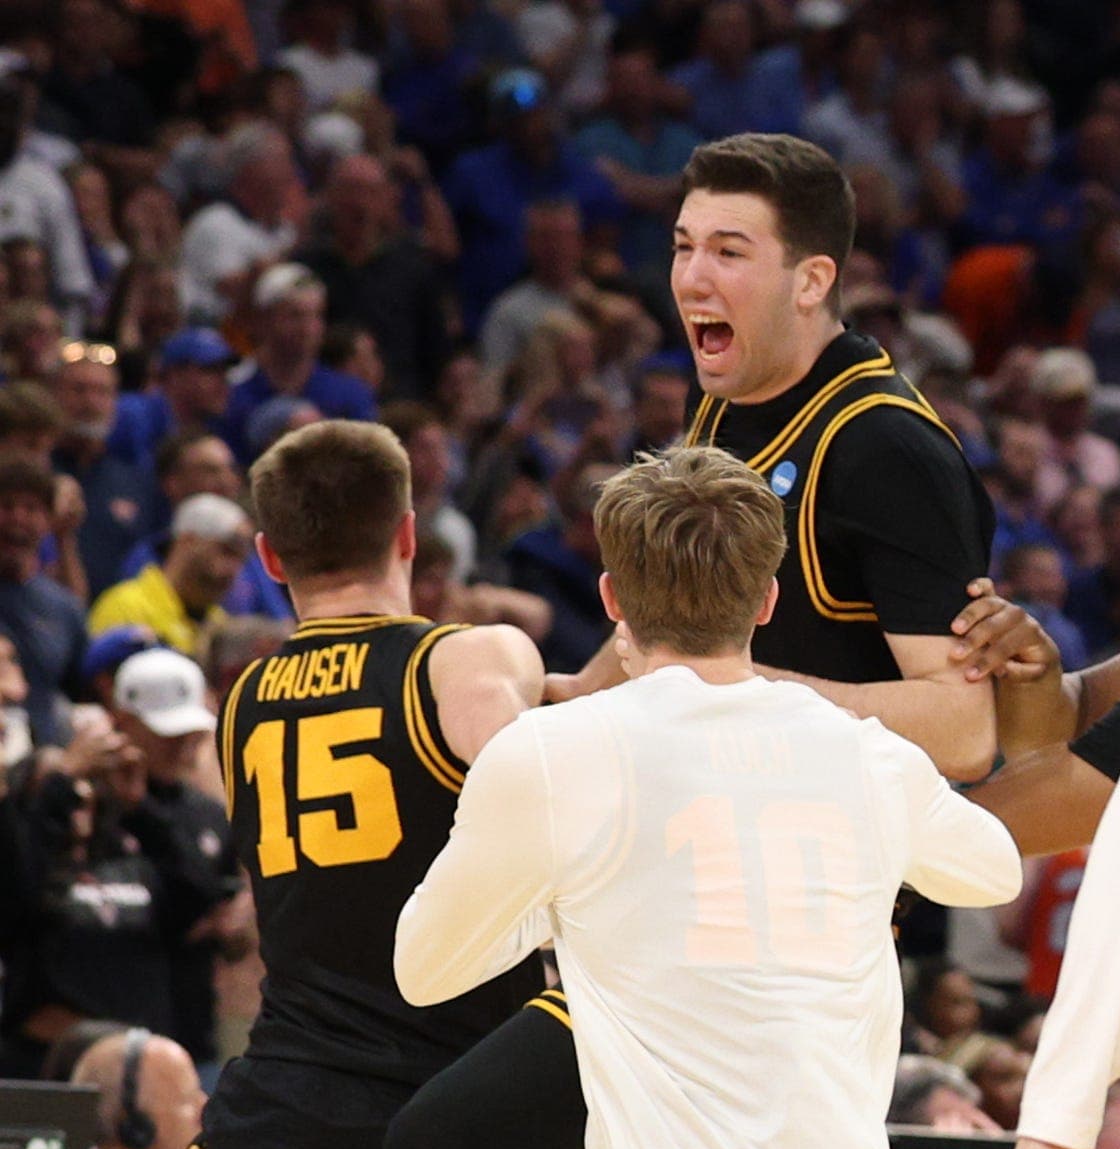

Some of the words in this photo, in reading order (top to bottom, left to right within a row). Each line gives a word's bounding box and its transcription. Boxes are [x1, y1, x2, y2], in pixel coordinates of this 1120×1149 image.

[257, 643, 370, 702] HAUSEN
[243, 707, 403, 878] 15
[664, 795, 858, 966] 10
